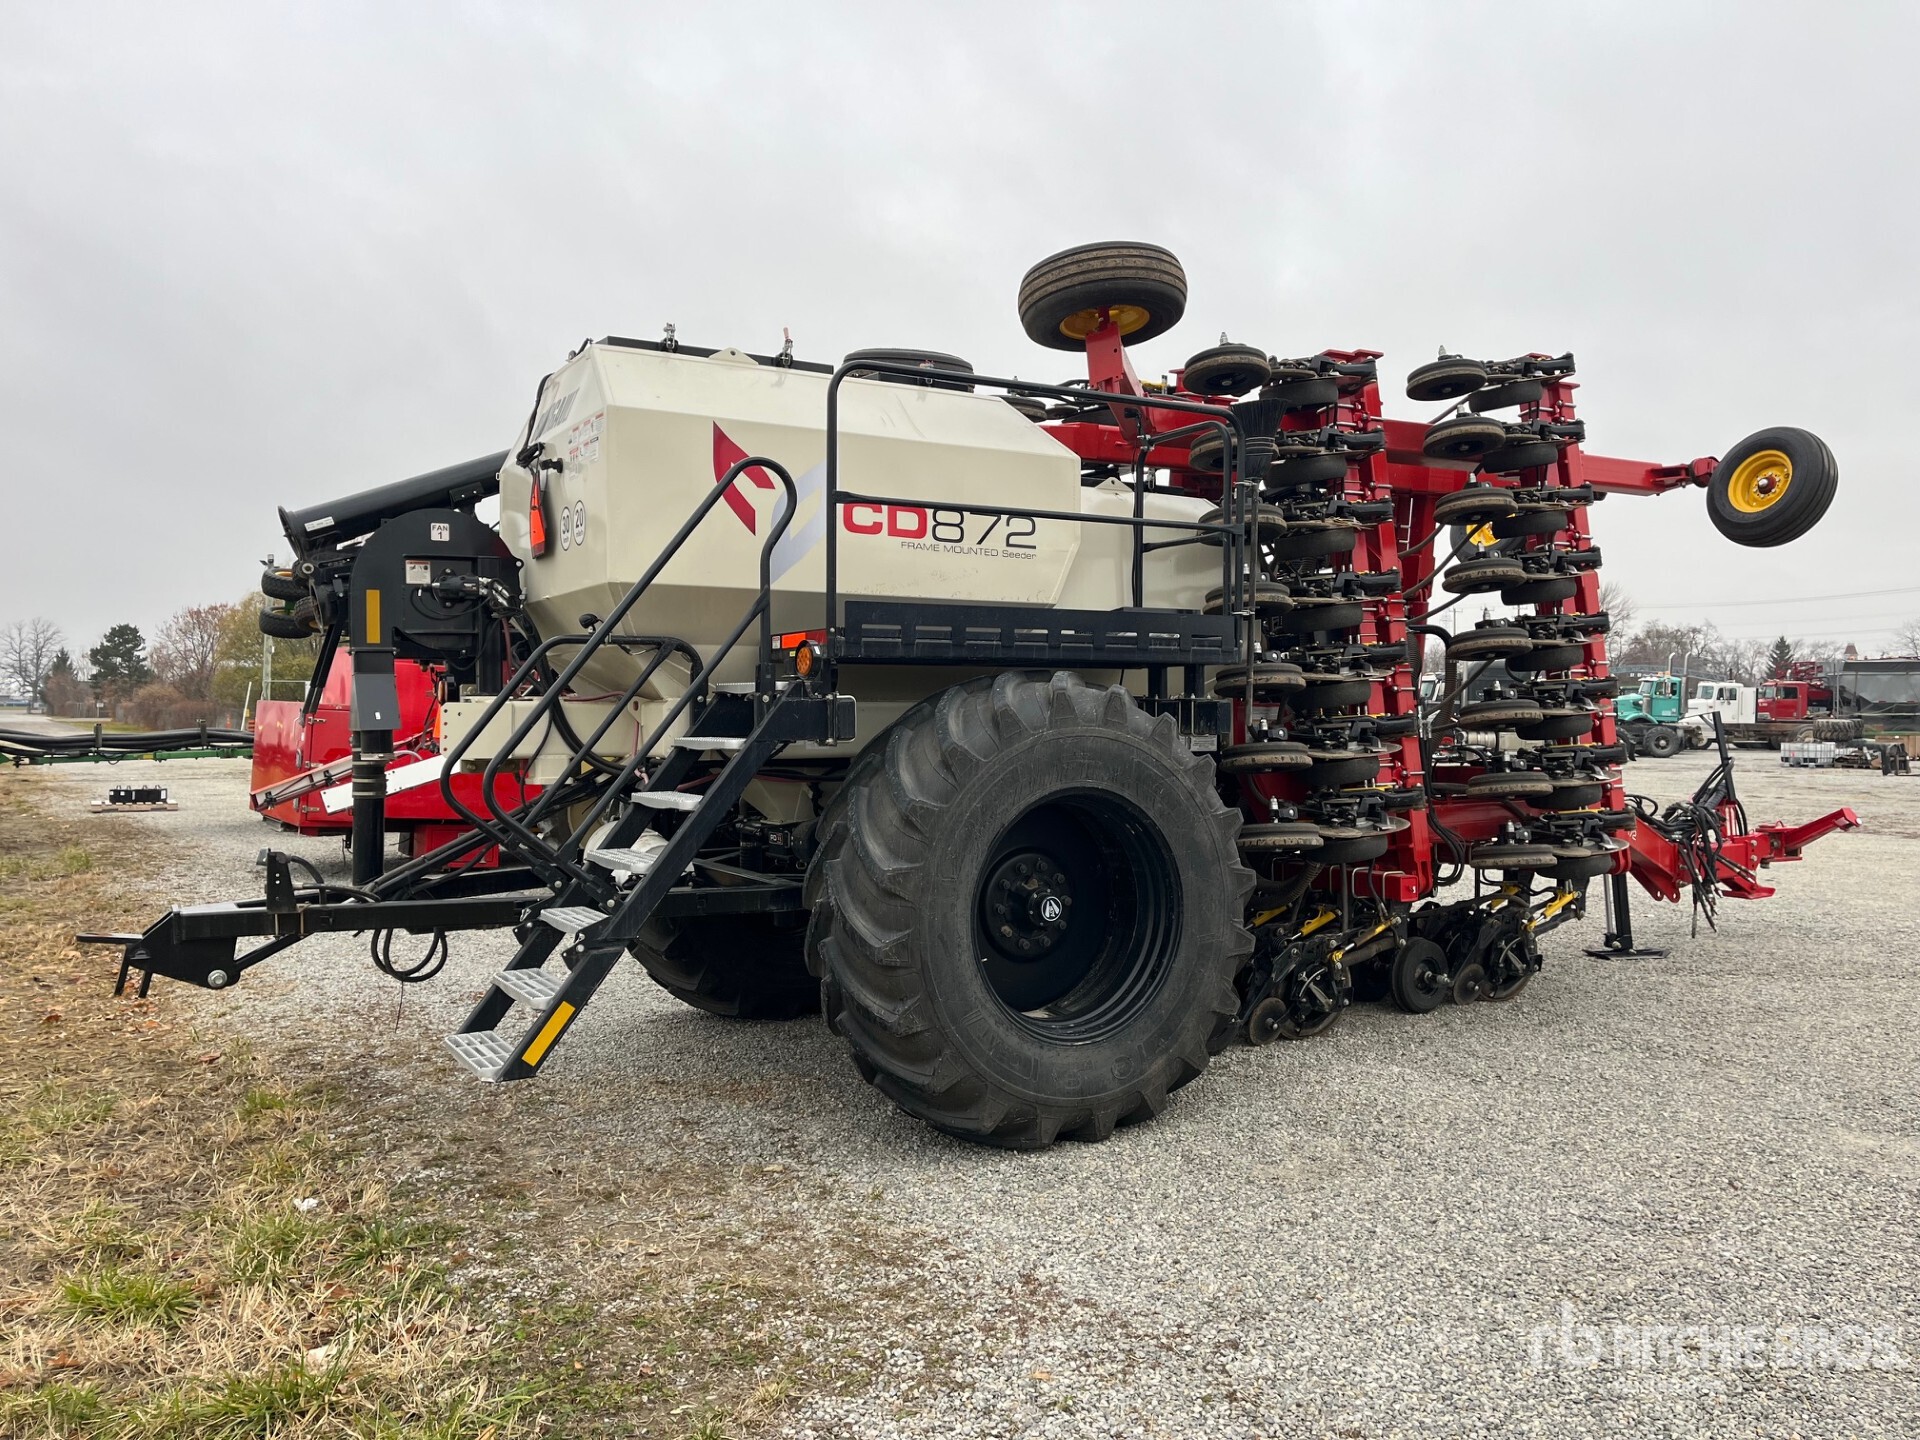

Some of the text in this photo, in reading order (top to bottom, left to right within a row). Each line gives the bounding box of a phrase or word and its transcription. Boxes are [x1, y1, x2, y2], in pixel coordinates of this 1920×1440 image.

[562, 515, 570, 534] 30
[575, 508, 584, 529] 20
[900, 541, 1037, 560] FRAME MOUNTED Seeder
